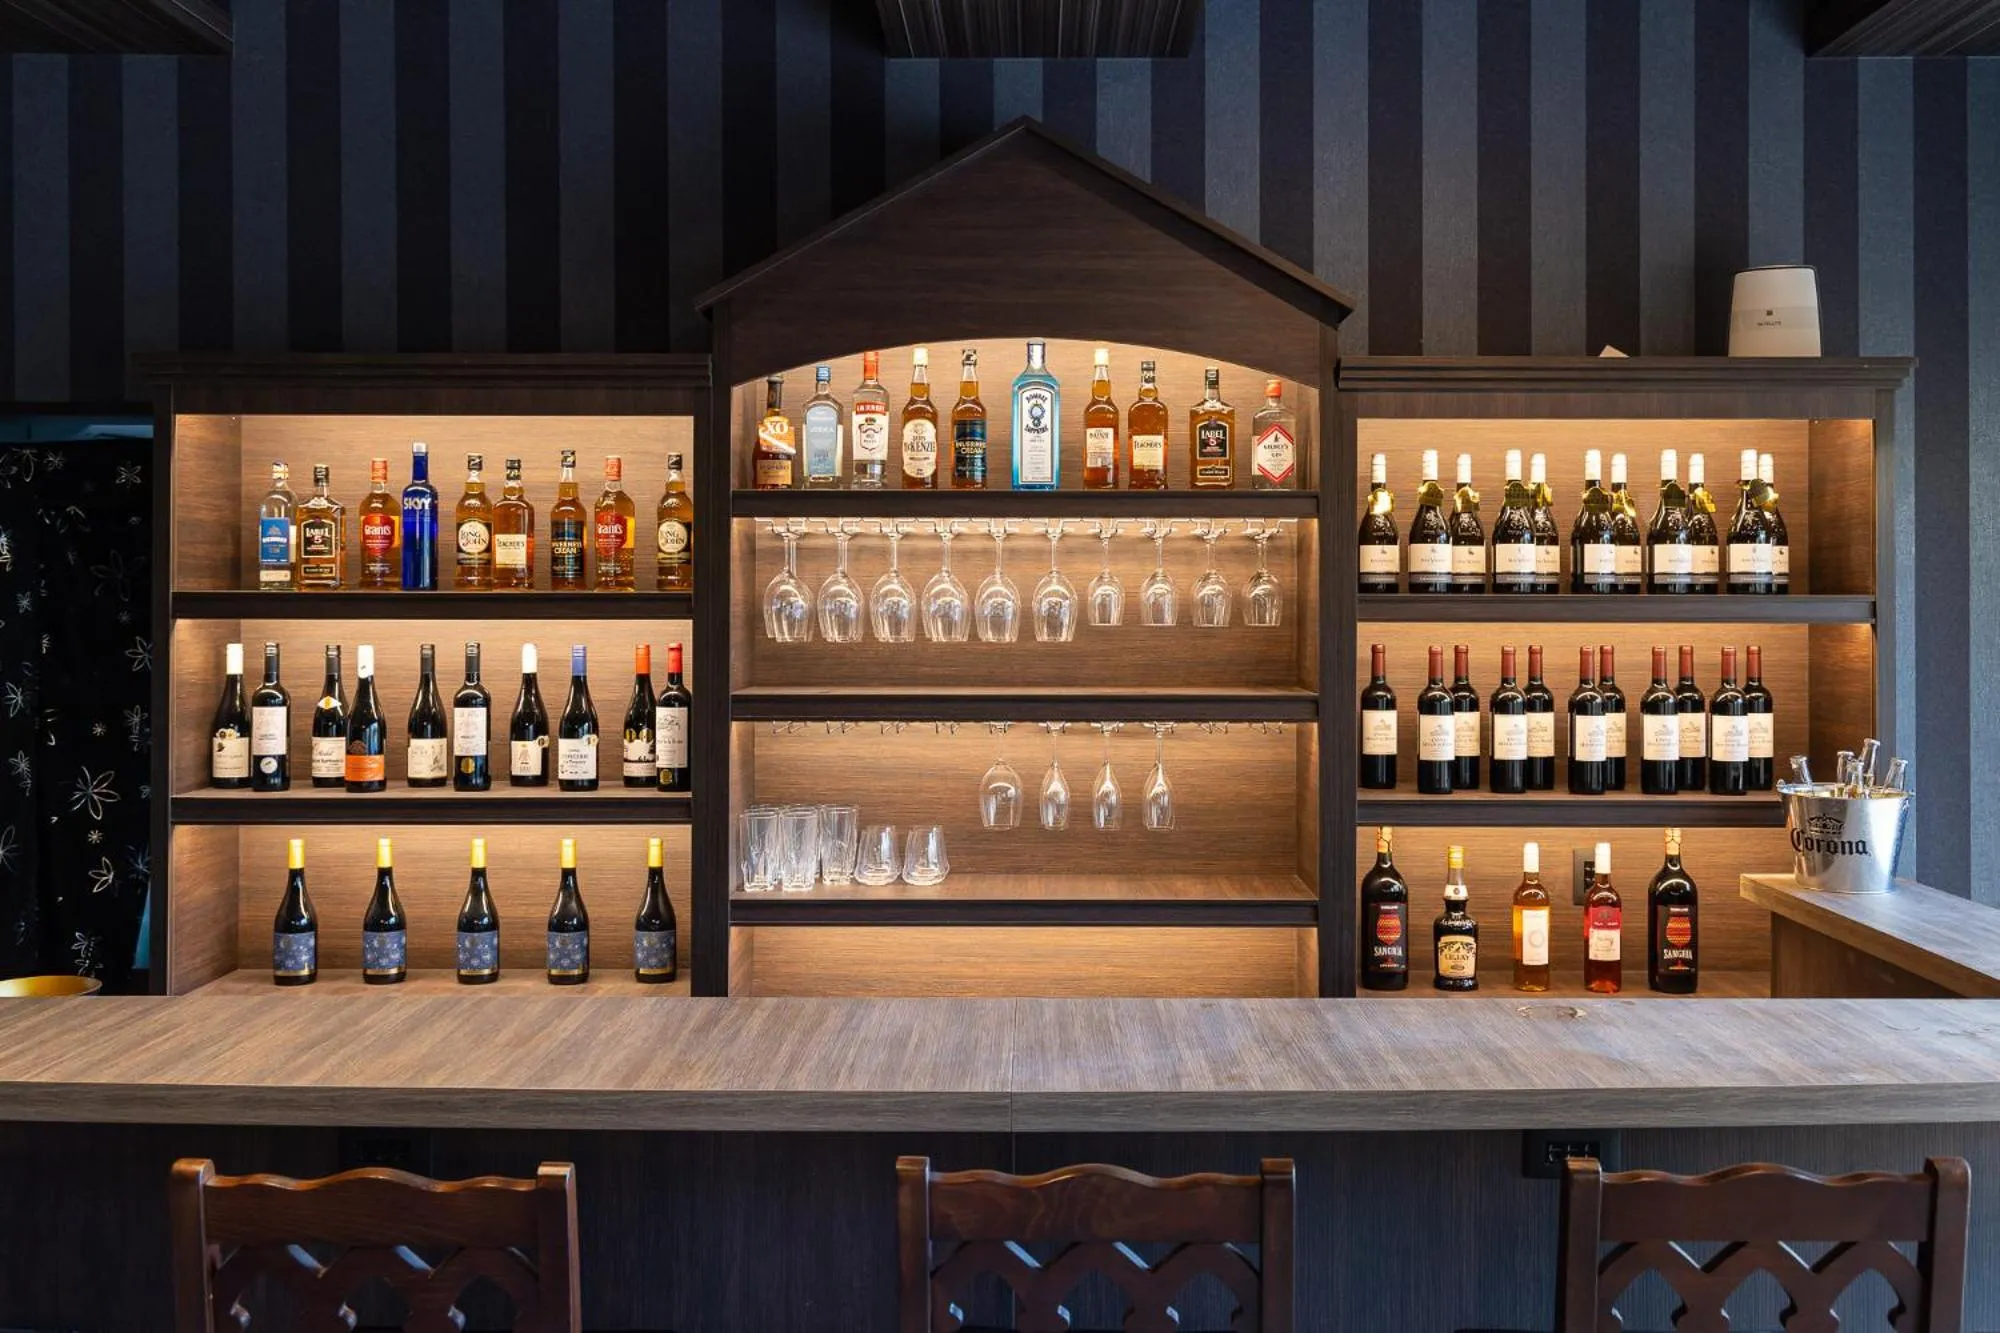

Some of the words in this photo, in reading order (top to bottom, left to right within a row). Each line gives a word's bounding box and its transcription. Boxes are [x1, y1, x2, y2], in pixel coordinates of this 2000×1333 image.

[766, 421, 789, 435] XO
[1201, 430, 1225, 439] LABEL
[1208, 437, 1217, 446] 5
[306, 527, 330, 538] LABEL
[314, 535, 323, 544] 5
[1790, 827, 1869, 856] Corona
[1373, 946, 1403, 957] SANGRIA
[1663, 948, 1693, 960] SANGRIA
